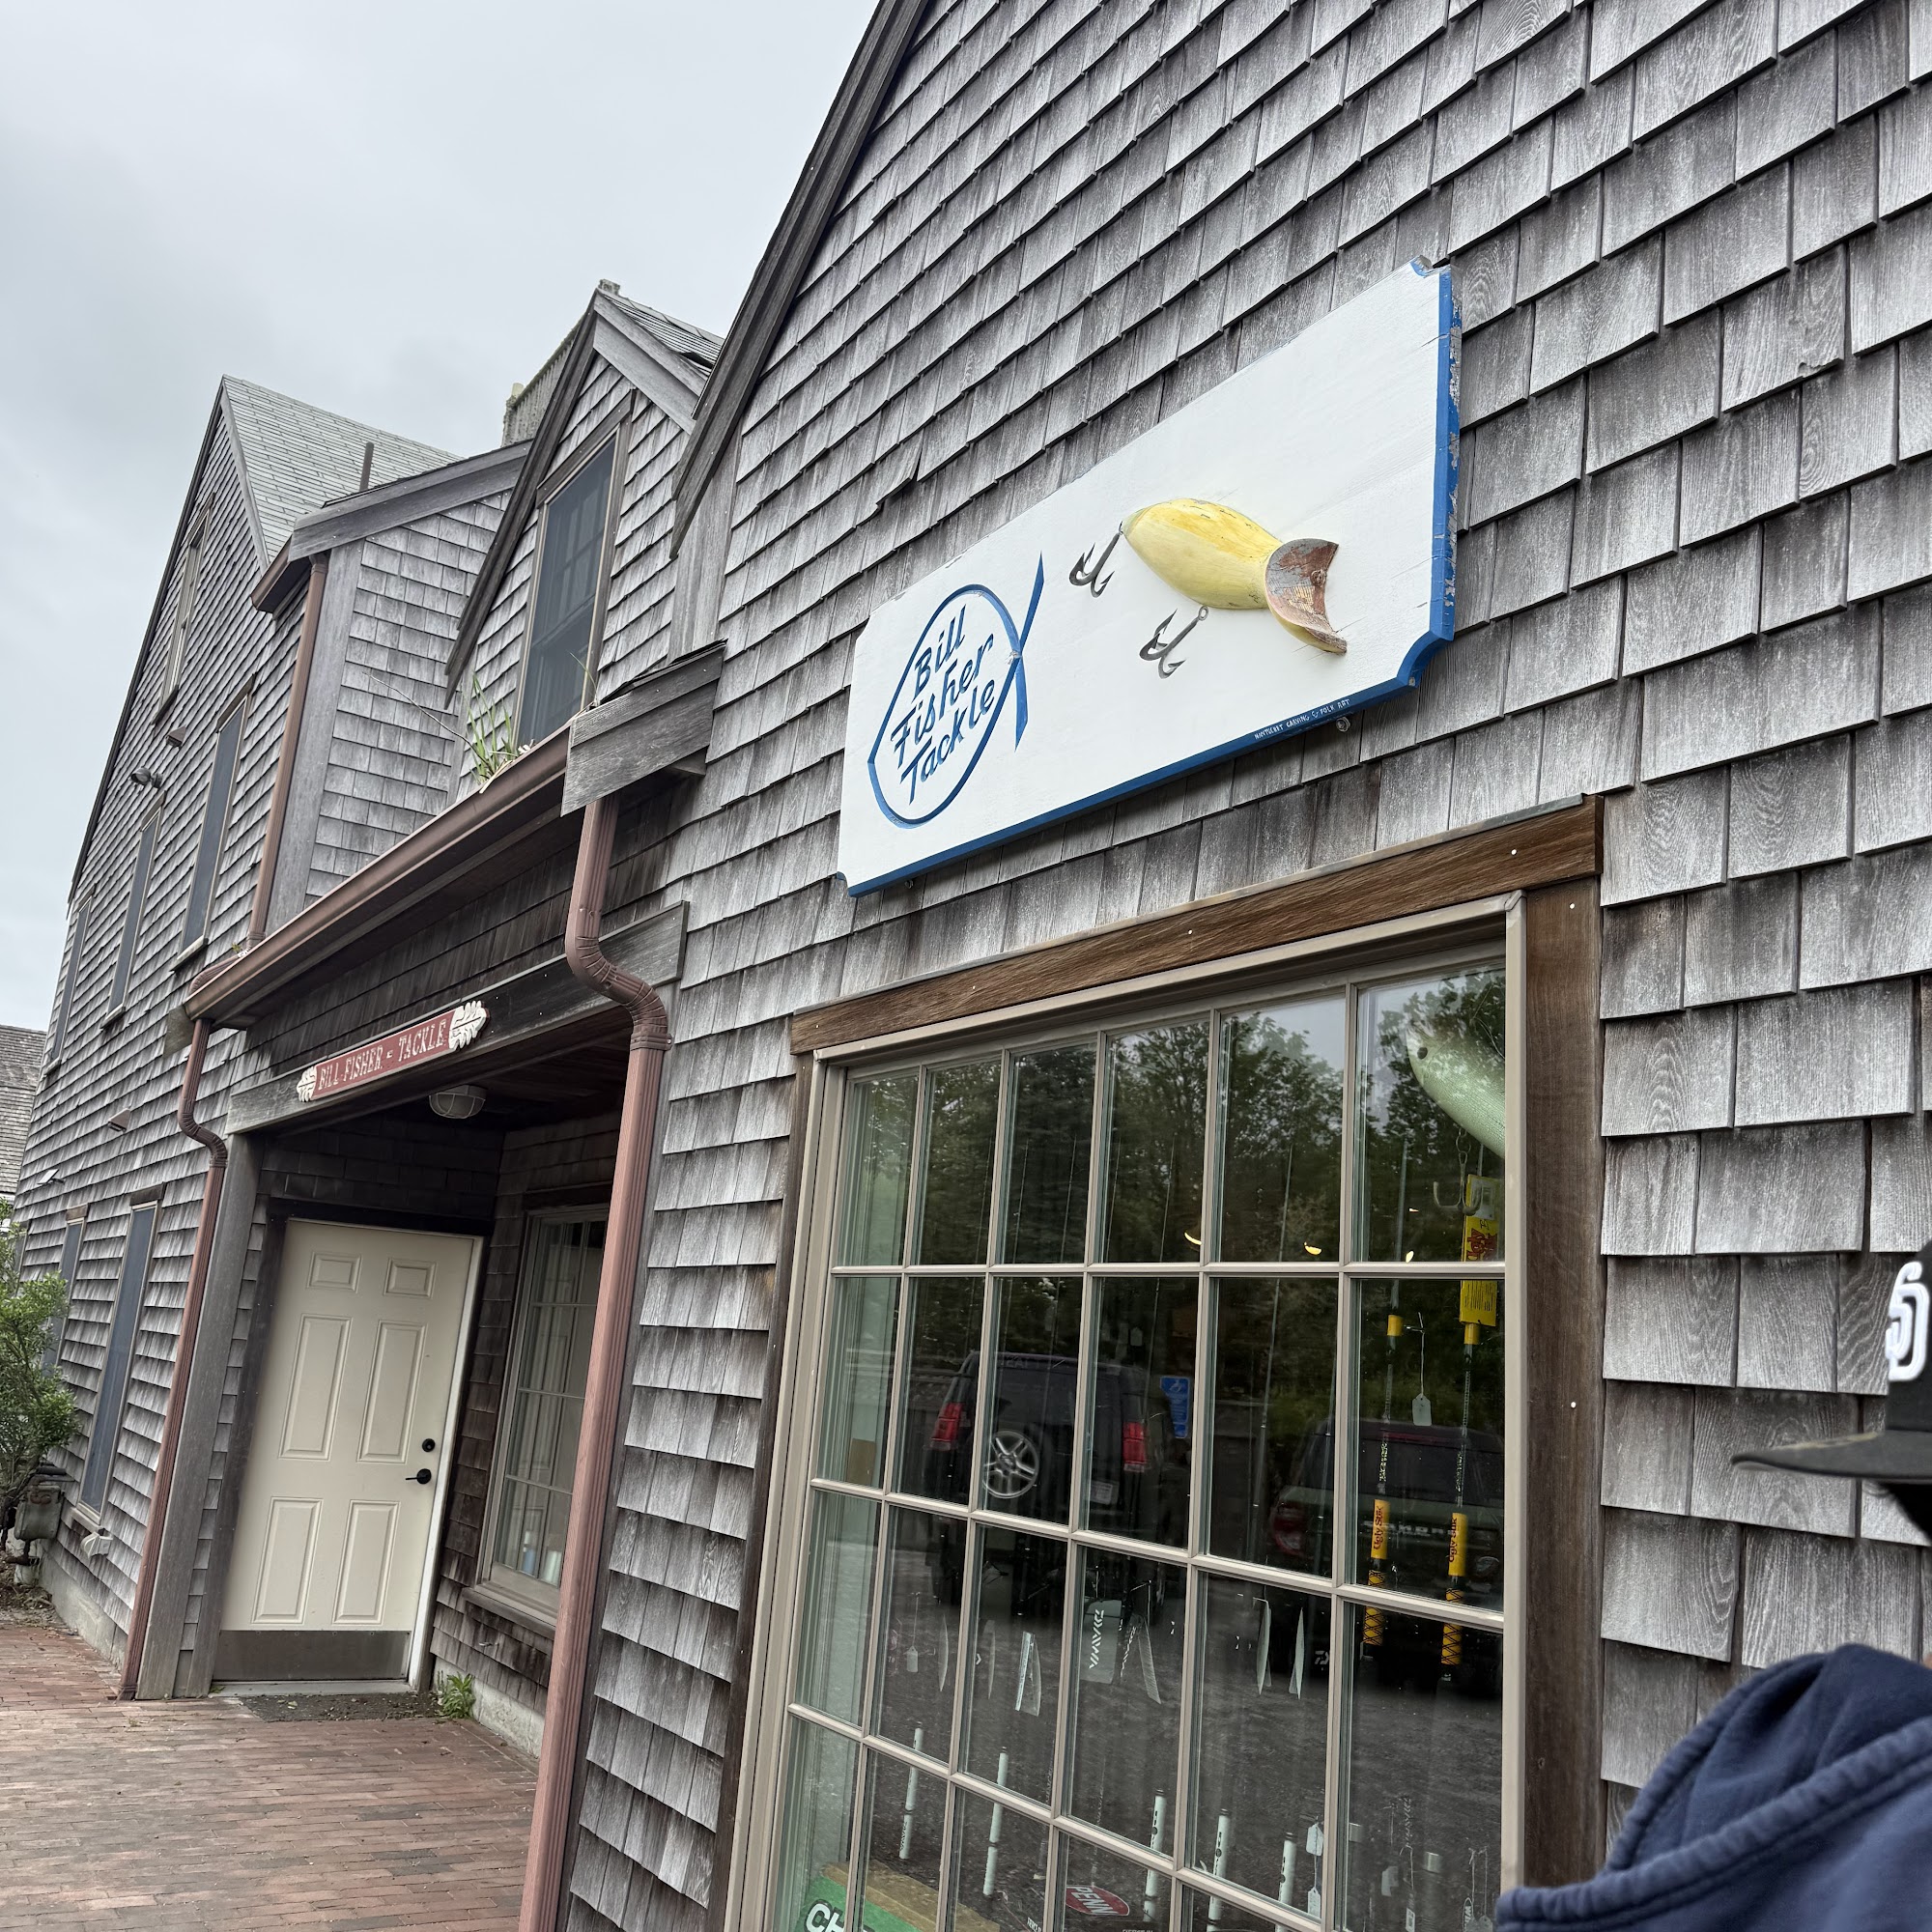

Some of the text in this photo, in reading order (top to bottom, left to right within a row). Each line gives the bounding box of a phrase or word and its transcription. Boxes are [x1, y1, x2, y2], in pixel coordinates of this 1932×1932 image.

[912, 604, 966, 703] Bill
[891, 634, 994, 770] Fisher
[900, 679, 995, 805] Tackle
[1286, 715, 1310, 727] CARVING
[1320, 705, 1335, 715] FOLK
[1338, 698, 1350, 709] ART
[318, 1063, 339, 1090] BILL
[343, 1045, 384, 1081] FISHER
[398, 1019, 447, 1062] TACKLE
[1066, 1887, 1119, 1914] PENN
